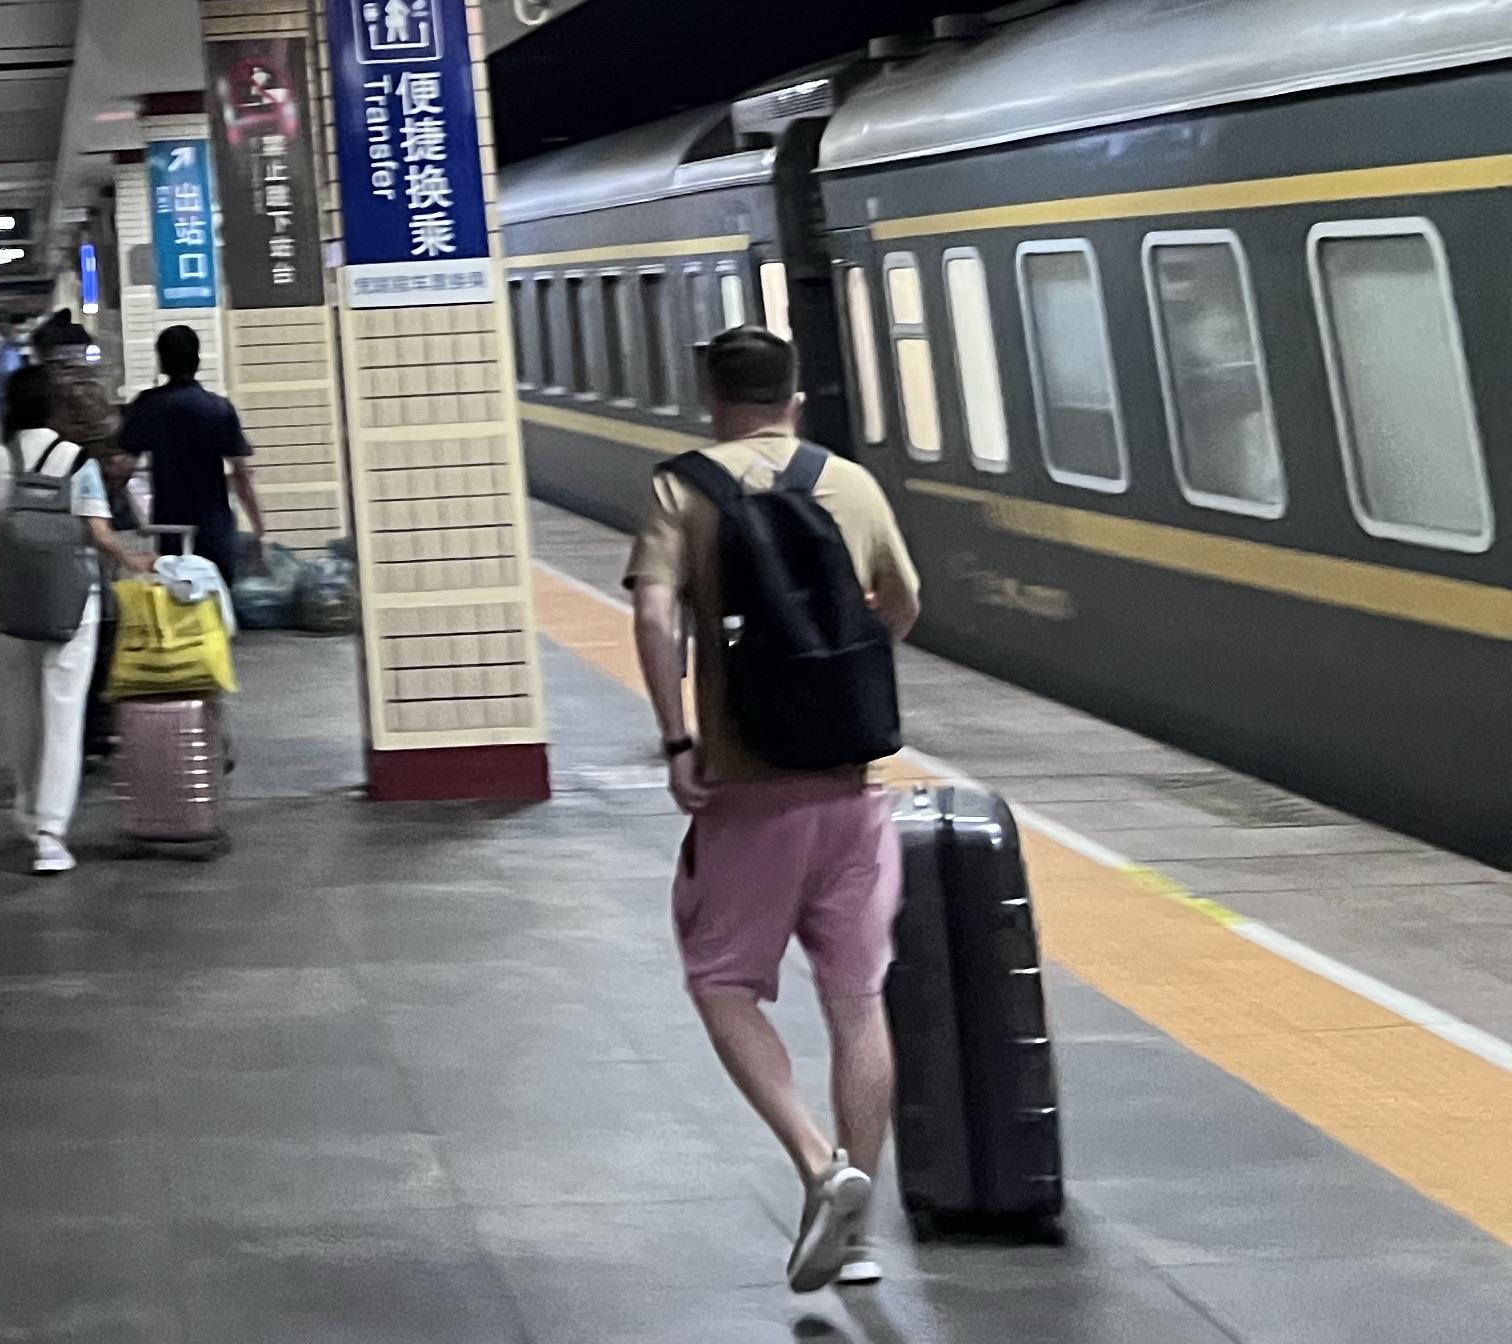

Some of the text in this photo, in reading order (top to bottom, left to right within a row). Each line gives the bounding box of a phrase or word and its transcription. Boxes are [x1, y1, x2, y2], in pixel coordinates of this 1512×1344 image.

[363, 73, 397, 202] Transfer
[394, 71, 457, 258] 便捷换乘
[173, 182, 208, 280] 出站口
